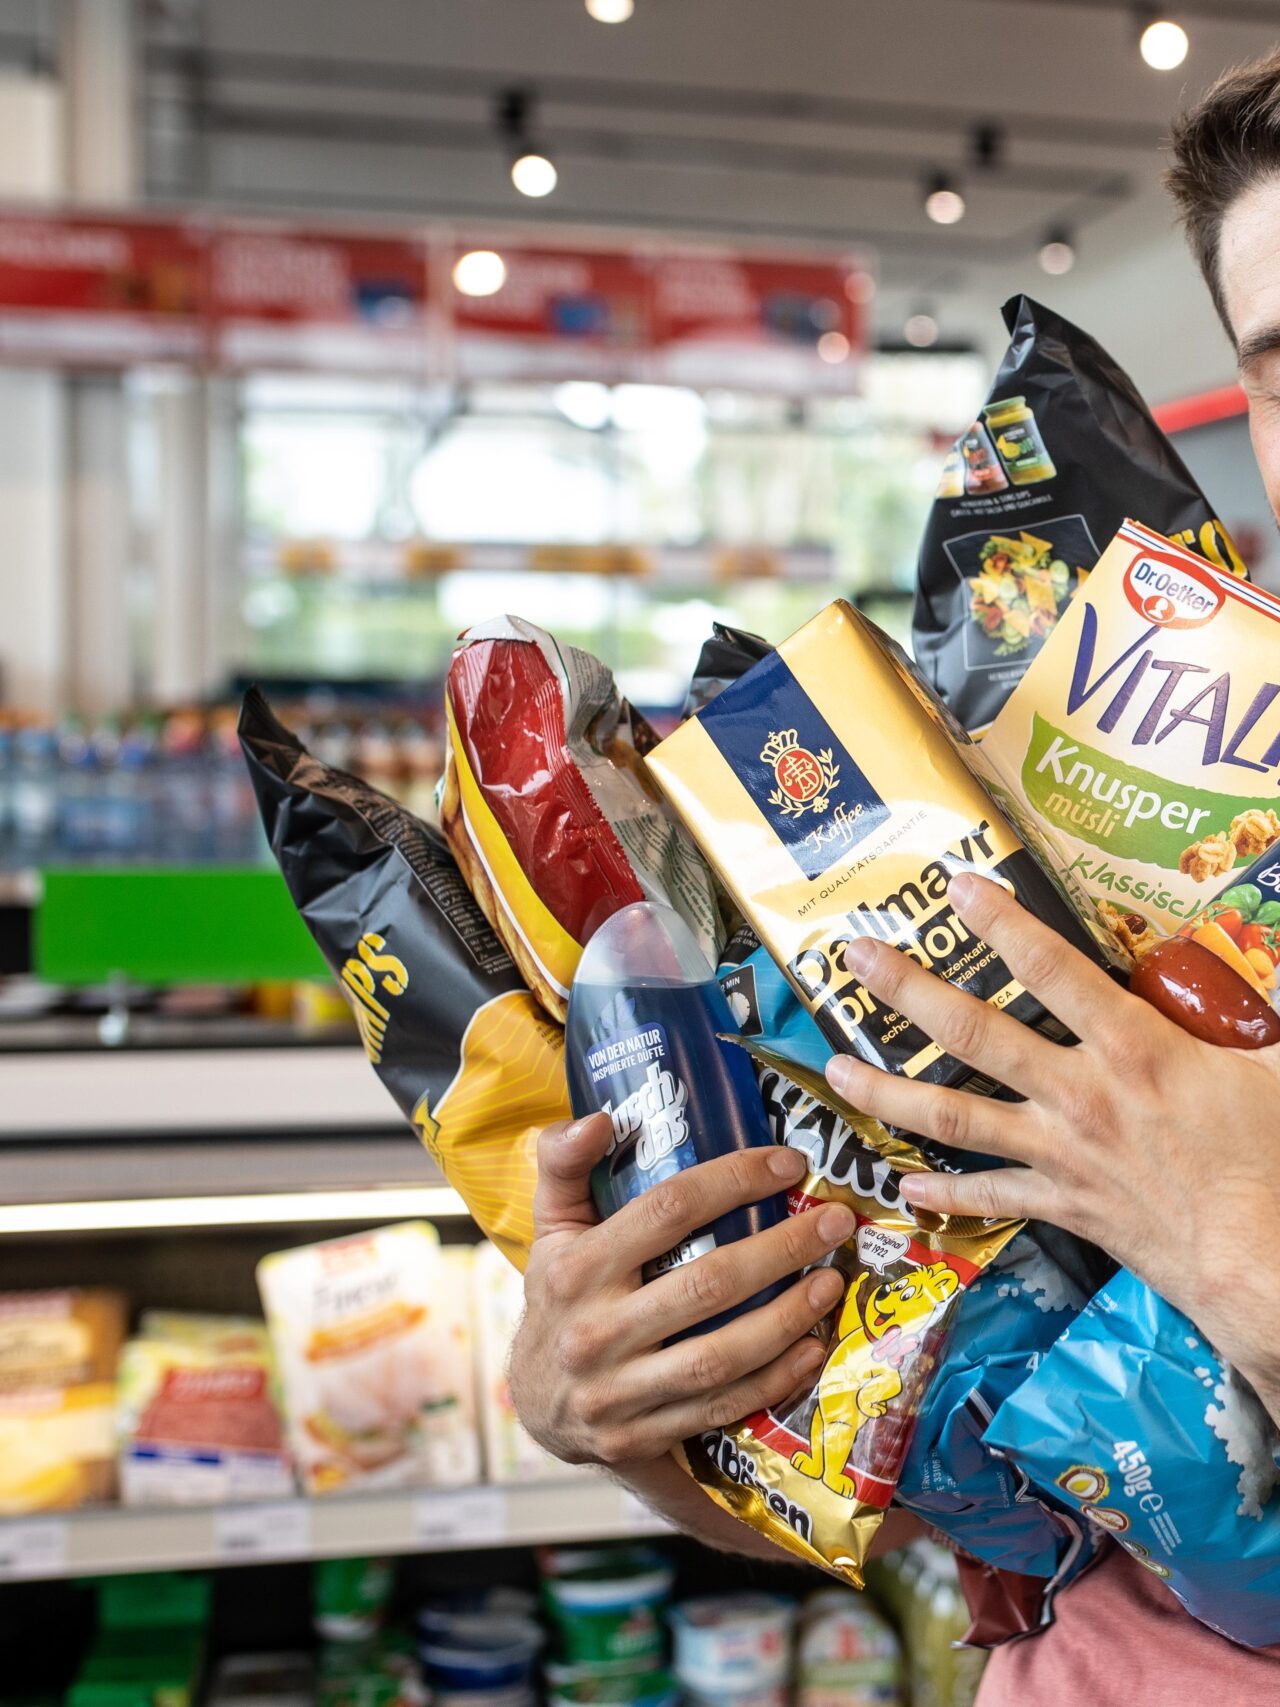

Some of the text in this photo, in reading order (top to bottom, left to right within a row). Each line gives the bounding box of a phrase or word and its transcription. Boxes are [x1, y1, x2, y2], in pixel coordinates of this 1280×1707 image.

[1036, 737, 1210, 835] Knusper
[802, 803, 865, 855] Kaffee
[1045, 790, 1121, 840] müsli
[797, 901, 817, 917] MIT
[588, 1029, 662, 1070] VON DER NATUR
[591, 1045, 665, 1082] INSPIRIERTE DÜFTE
[636, 1107, 690, 1171] das
[861, 1239, 889, 1258] seit 1922
[876, 1231, 905, 1250] Original
[1113, 1440, 1153, 1498] 450g
